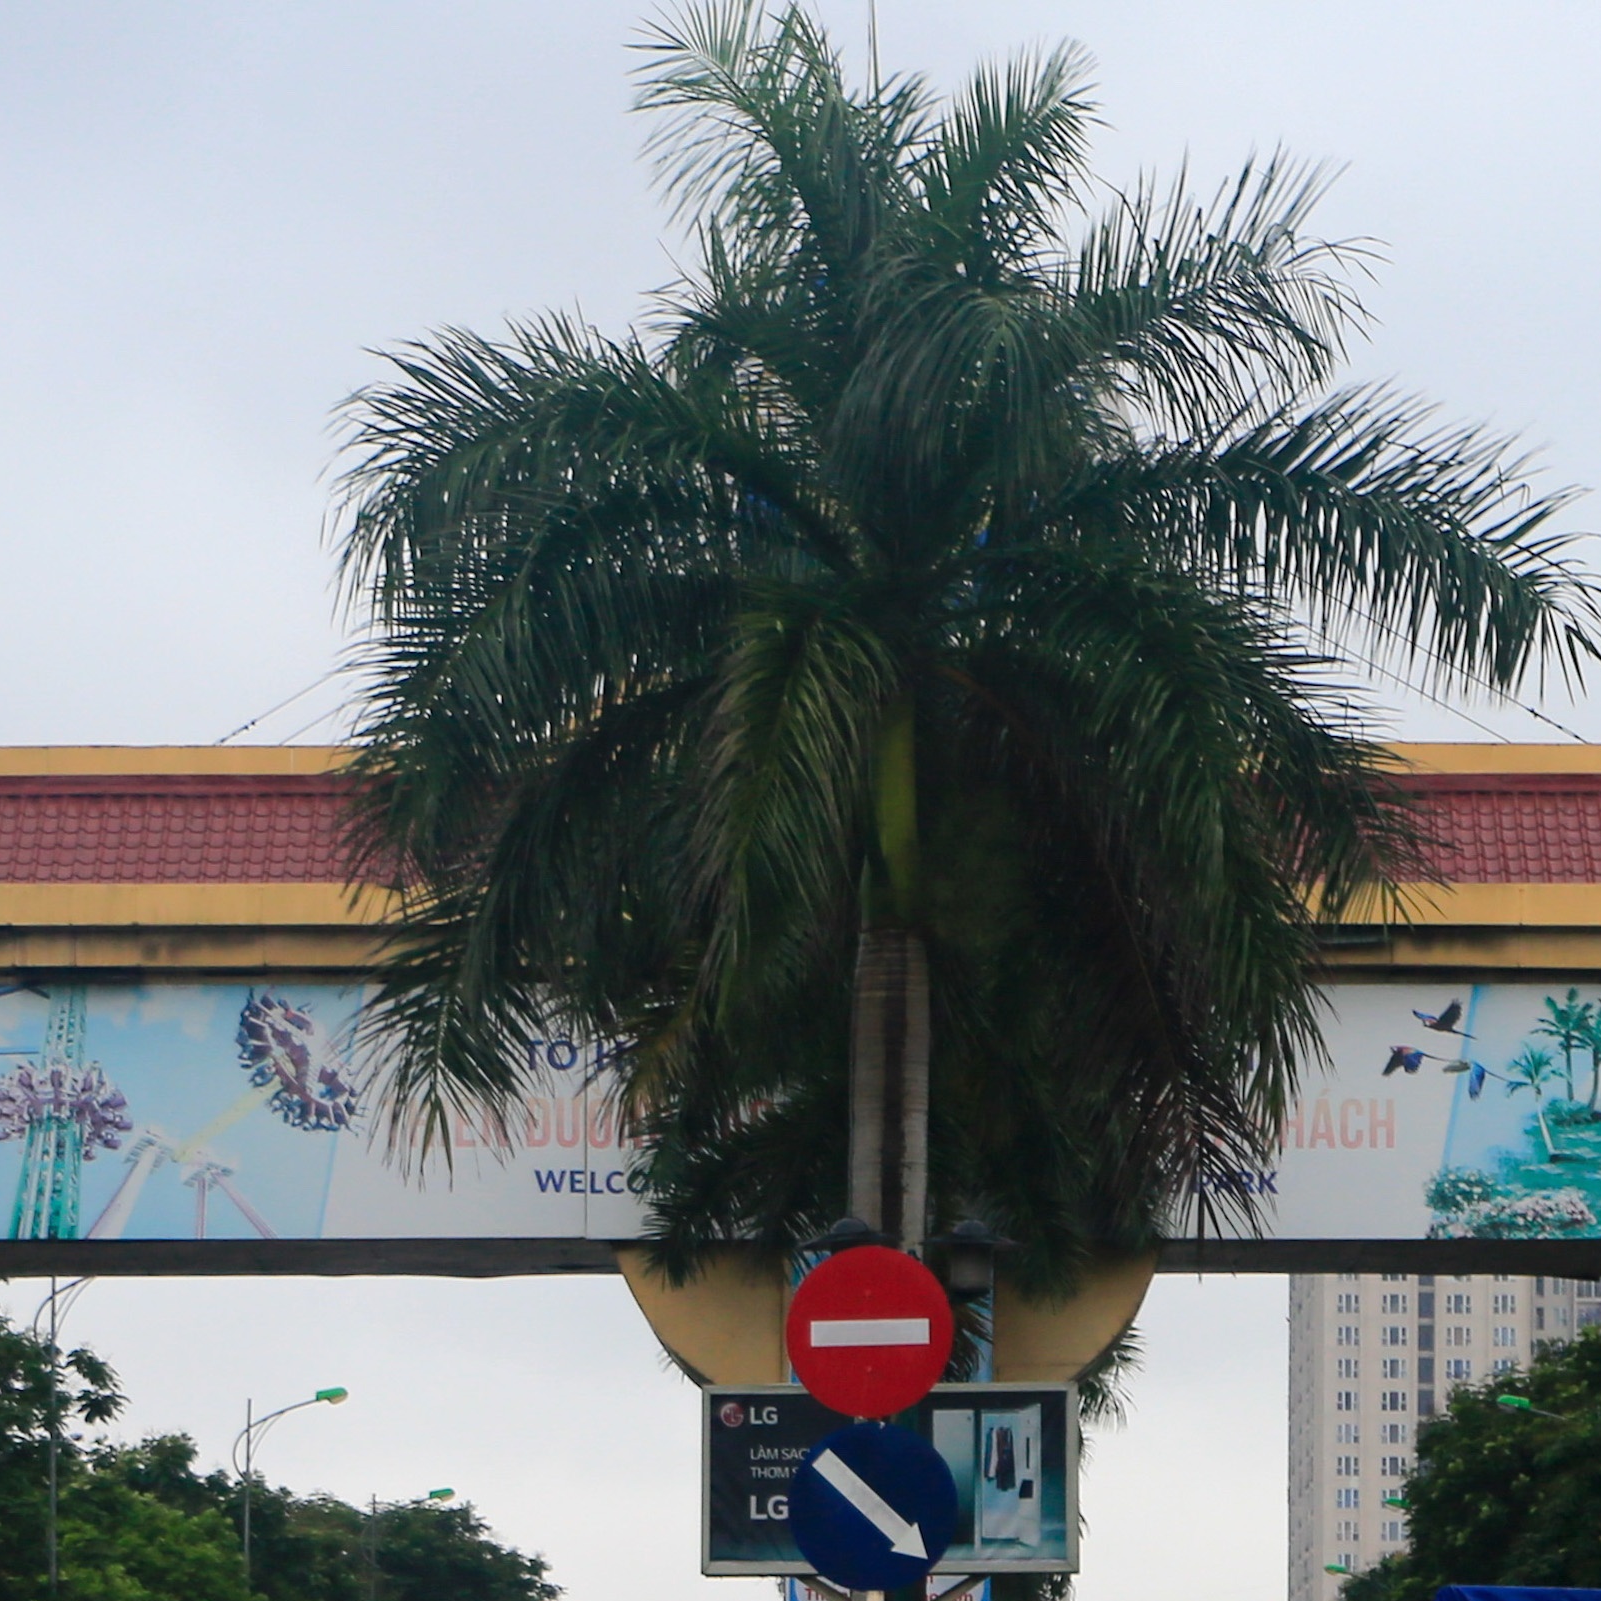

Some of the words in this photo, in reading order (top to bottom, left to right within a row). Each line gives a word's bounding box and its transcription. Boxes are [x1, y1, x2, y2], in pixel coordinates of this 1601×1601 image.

[1254, 1088, 1396, 1149] HÁCH
[750, 1406, 778, 1425] LG
[750, 1444, 779, 1460] LÀM
[750, 1495, 789, 1520] LG
